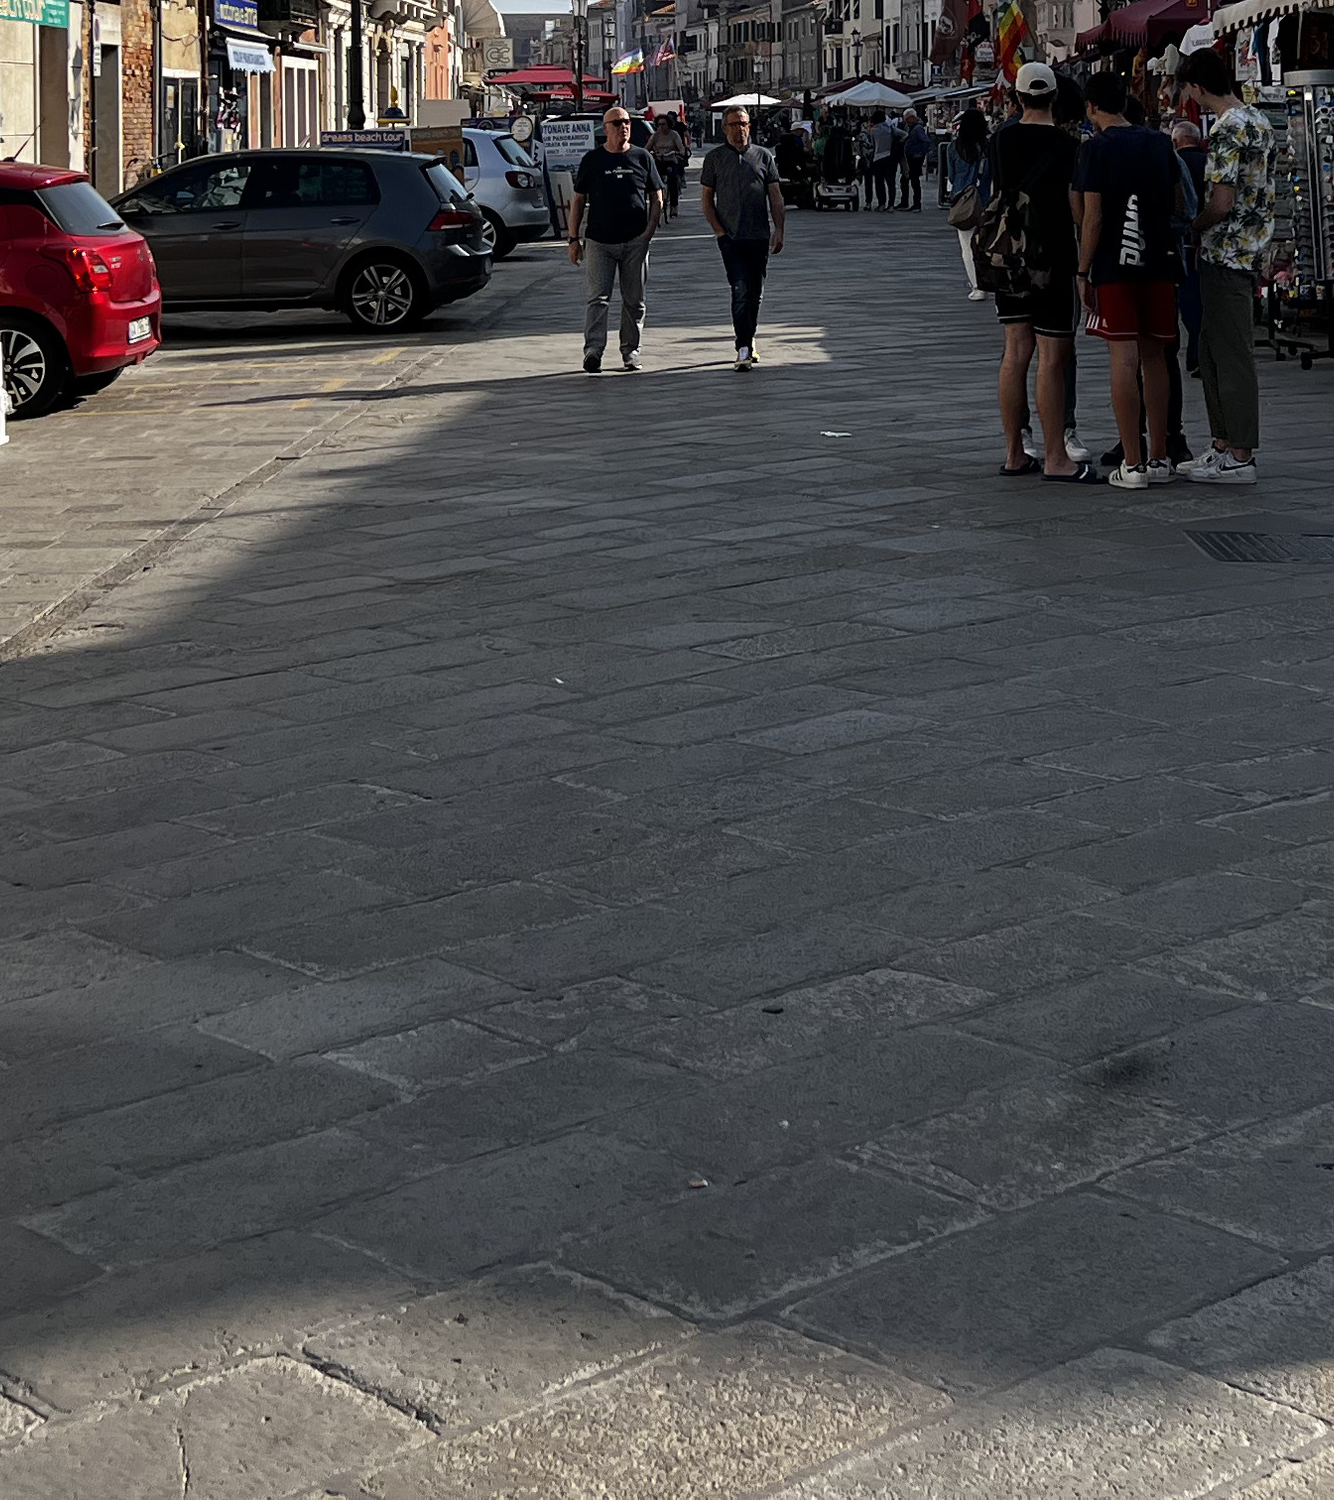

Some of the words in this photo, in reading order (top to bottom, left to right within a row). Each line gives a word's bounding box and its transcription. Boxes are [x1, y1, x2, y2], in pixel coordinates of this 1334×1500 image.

[571, 122, 591, 133] ANNA
[321, 132, 353, 142] dreams
[354, 132, 382, 142] beach
[383, 132, 404, 142] tour
